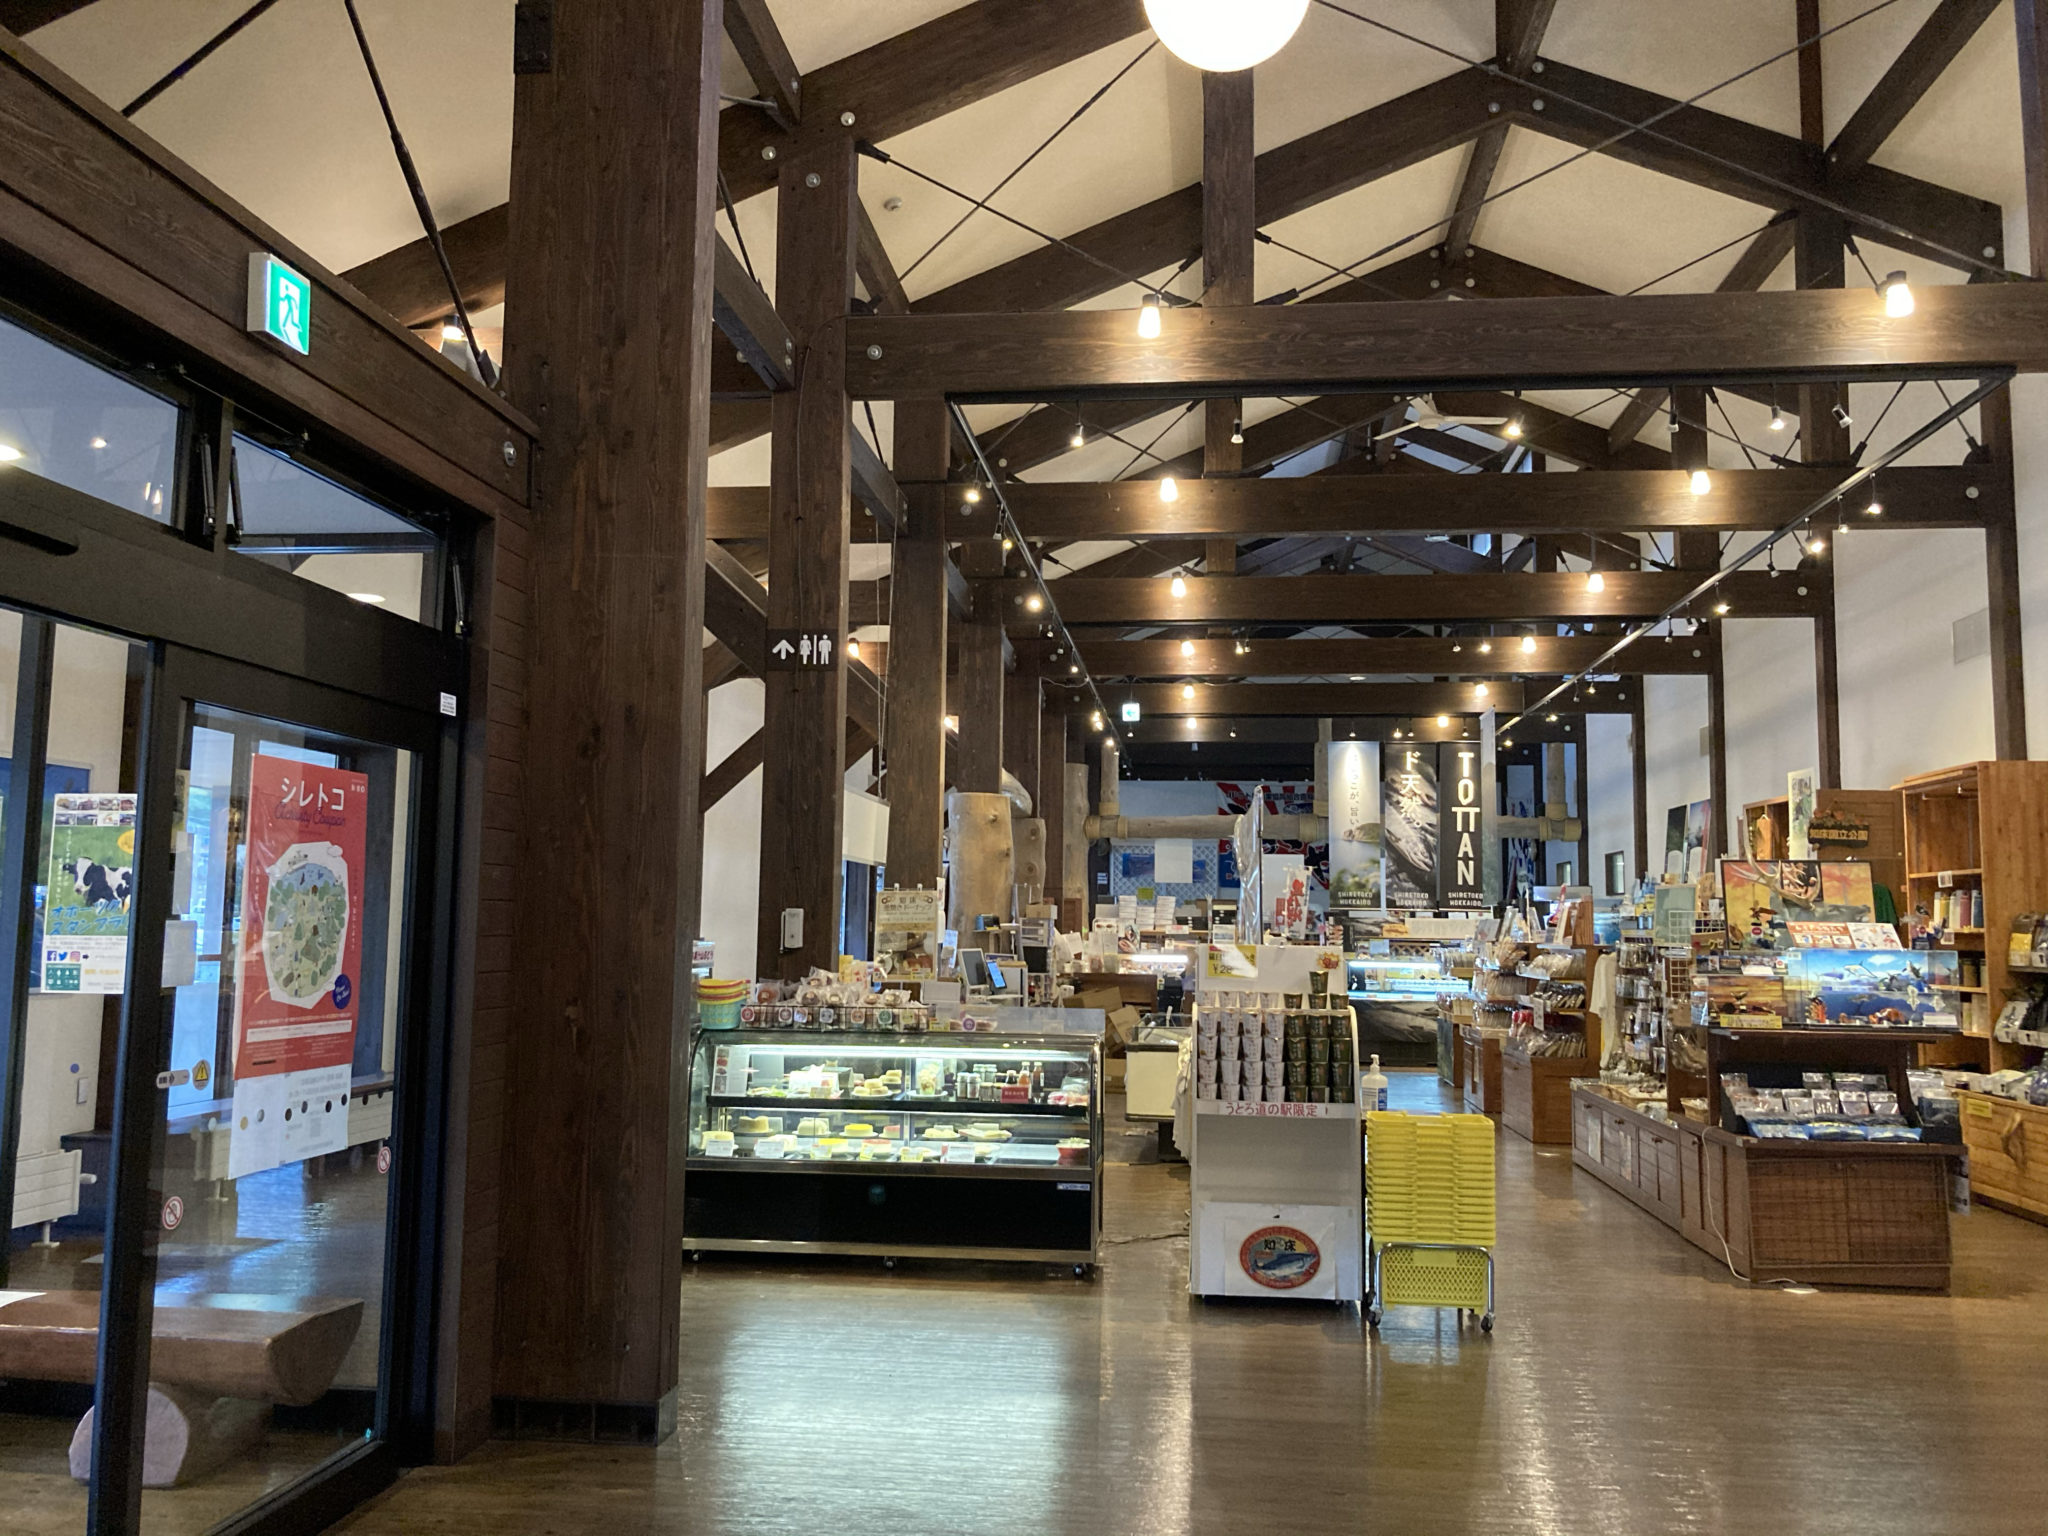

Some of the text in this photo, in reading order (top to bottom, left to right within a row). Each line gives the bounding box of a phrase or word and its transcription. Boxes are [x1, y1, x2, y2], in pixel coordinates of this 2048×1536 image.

[281, 777, 345, 811] シレトコ
[1337, 891, 1373, 899] SHIRETOKO
[1447, 892, 1484, 900] SHIRETOKO
[1263, 1238, 1297, 1252] 知床
